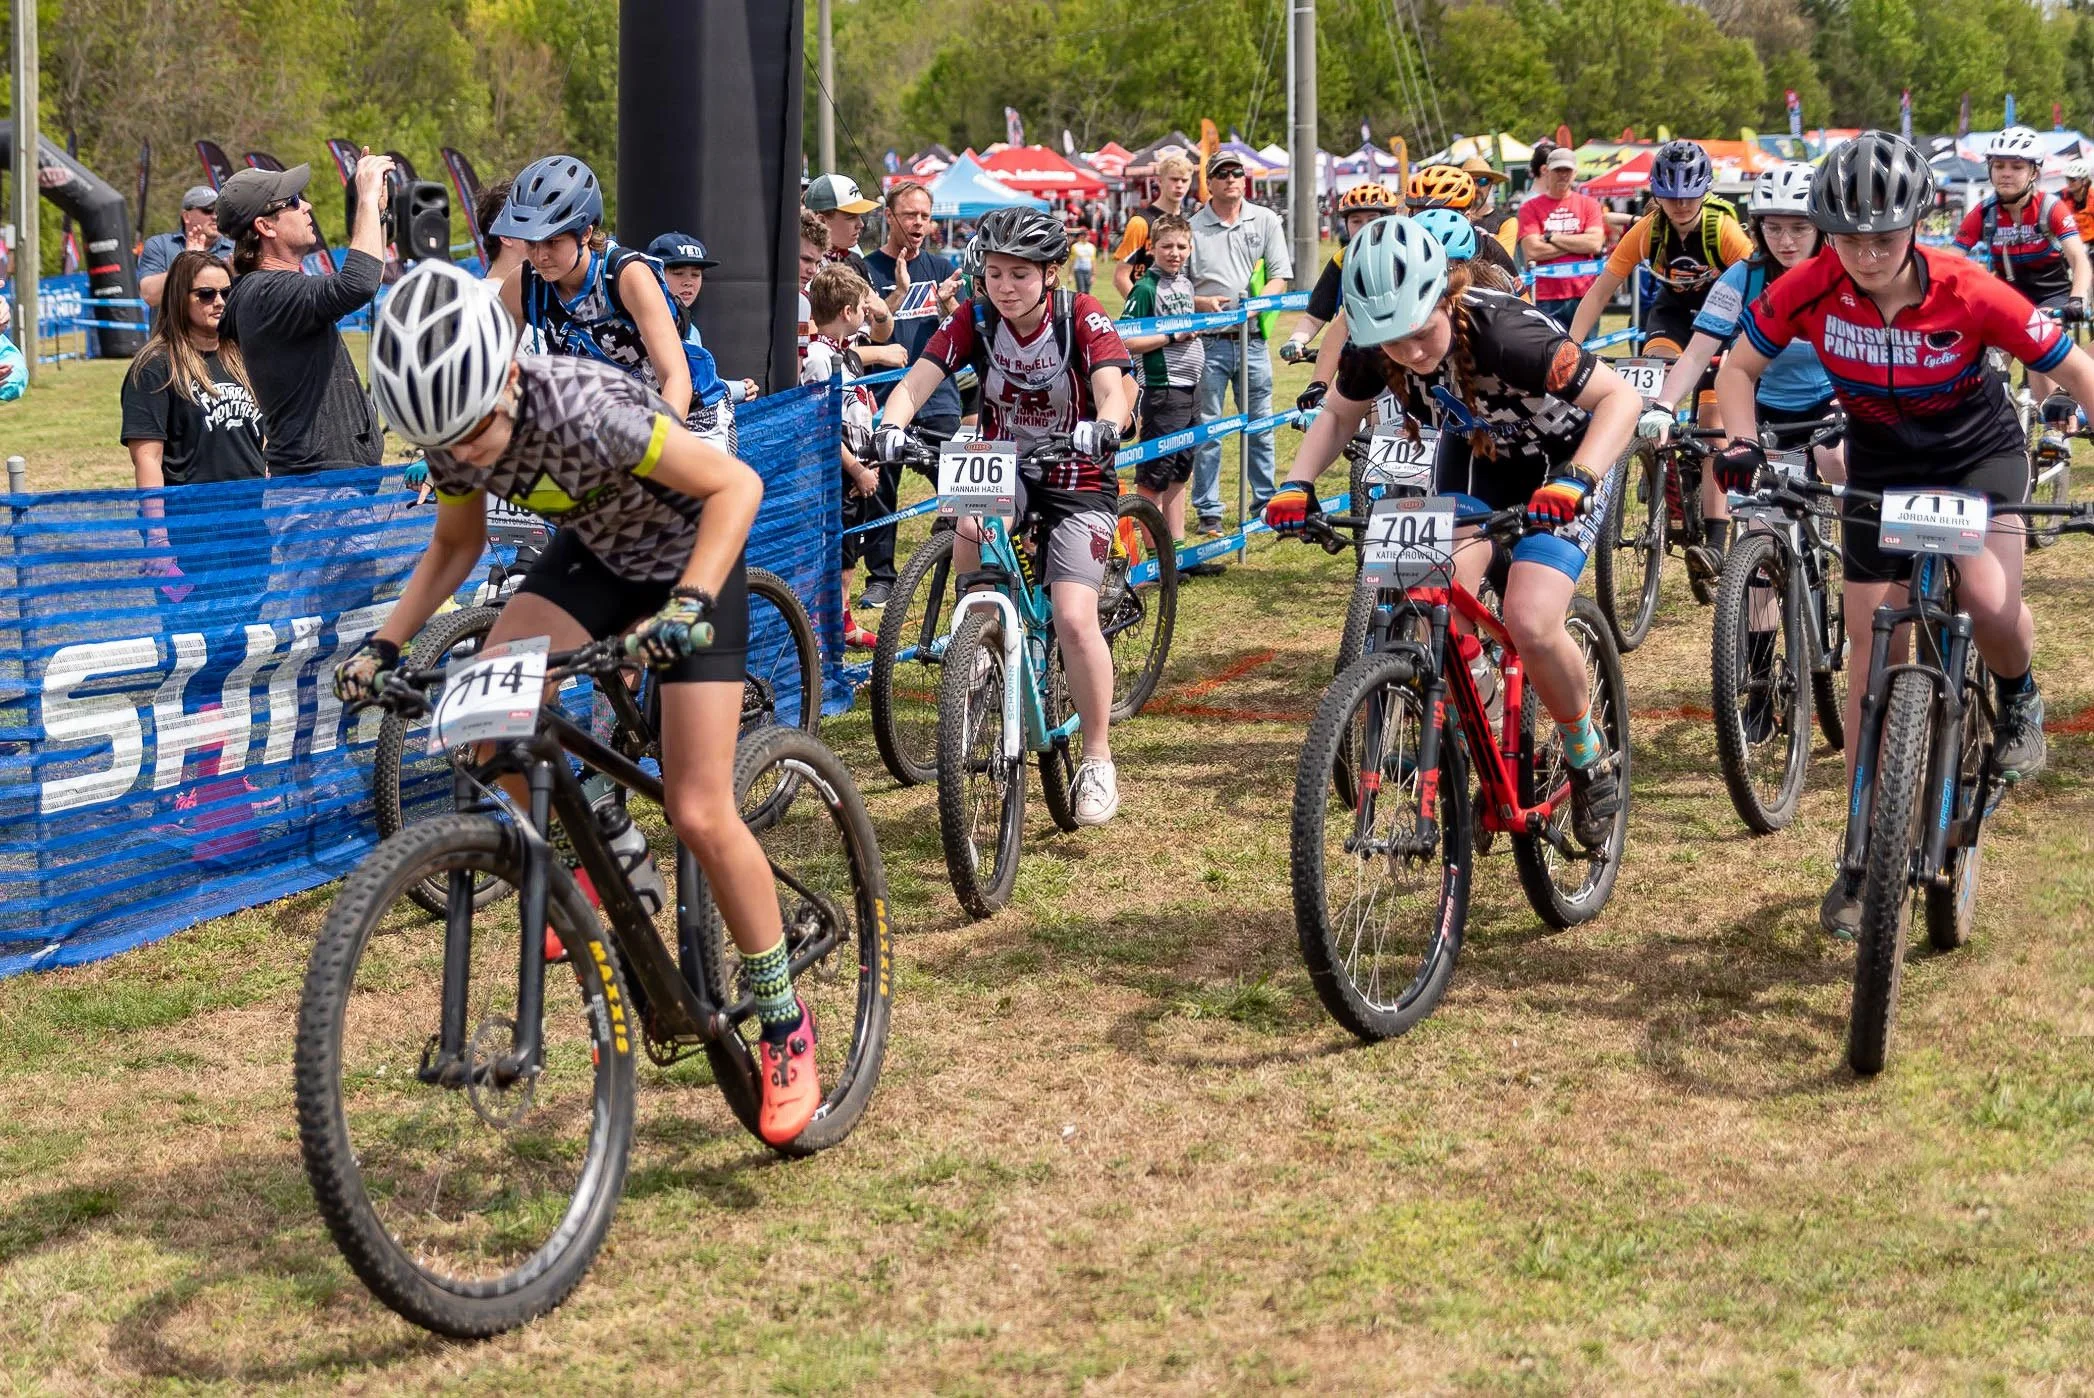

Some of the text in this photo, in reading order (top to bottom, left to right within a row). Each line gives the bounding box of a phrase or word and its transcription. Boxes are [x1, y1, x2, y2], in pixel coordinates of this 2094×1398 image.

[677, 245, 703, 259] YETI
[1085, 312, 1114, 333] BR
[1825, 314, 1922, 347] HUNTSVILLE
[1824, 334, 1918, 365] PANTHERS
[1923, 352, 1961, 368] Cyclin
[1620, 369, 1654, 389] 713
[1013, 414, 1049, 428] BIKING
[1157, 431, 1195, 454] SHIMANO
[1382, 439, 1426, 464] 702
[1114, 446, 1144, 468] IMANO
[952, 456, 1003, 484] 706
[950, 485, 1004, 493] HANNAH HAZEL
[1904, 495, 1965, 516] 711
[1897, 512, 1971, 526] JORDAN BERRY
[1381, 515, 1438, 548] 704
[1376, 551, 1440, 560] KATIE PROWELL
[457, 660, 523, 706] 714
[1007, 664, 1016, 721] SCHWINN
[875, 898, 889, 996] MAXXIS
[589, 940, 629, 1054] MAXXIS
